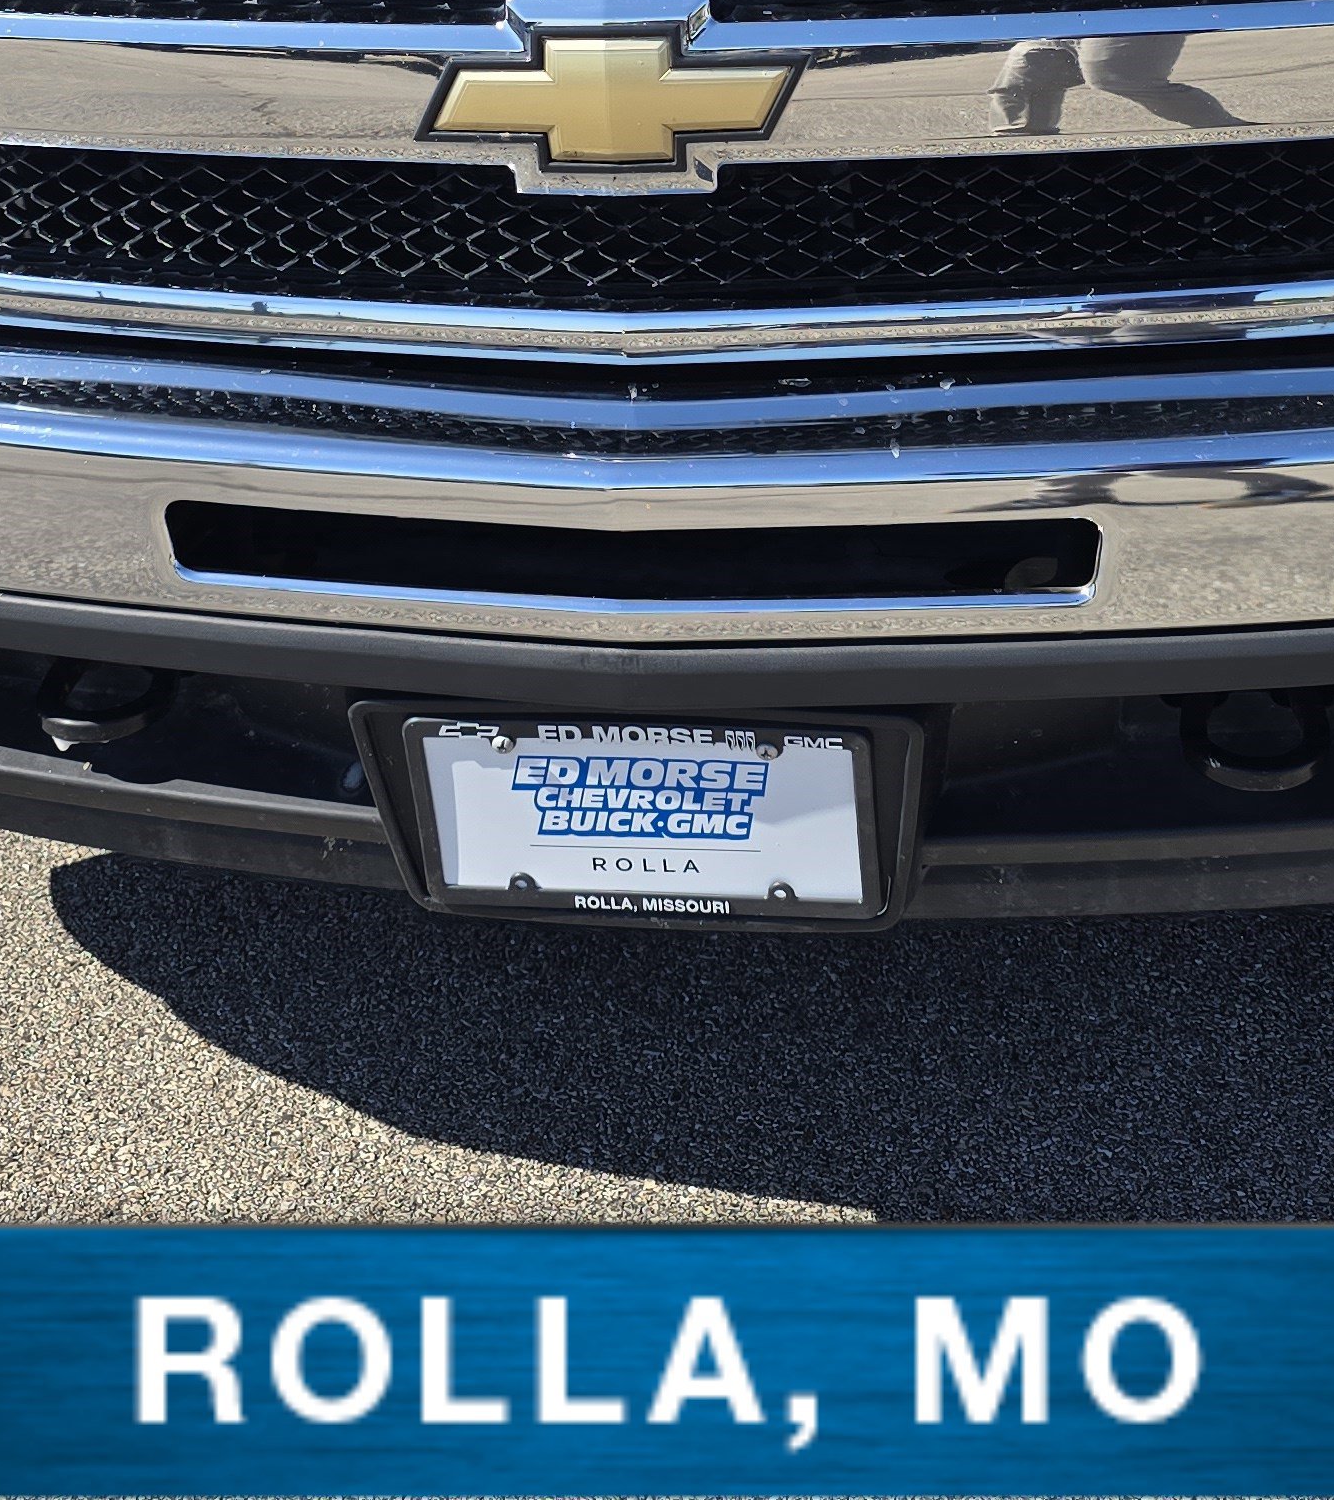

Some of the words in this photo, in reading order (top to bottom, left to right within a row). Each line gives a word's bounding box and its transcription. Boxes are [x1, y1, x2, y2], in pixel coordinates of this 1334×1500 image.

[537, 725, 583, 744] ED
[591, 725, 713, 747] MORSE
[782, 735, 844, 750] GMC
[514, 757, 581, 786] ED
[584, 758, 766, 792] MORSE
[536, 786, 750, 813] CHEVROLET
[591, 857, 701, 874] ROLLA
[574, 895, 638, 913] ROLLA,
[642, 896, 730, 915] MISSOURI
